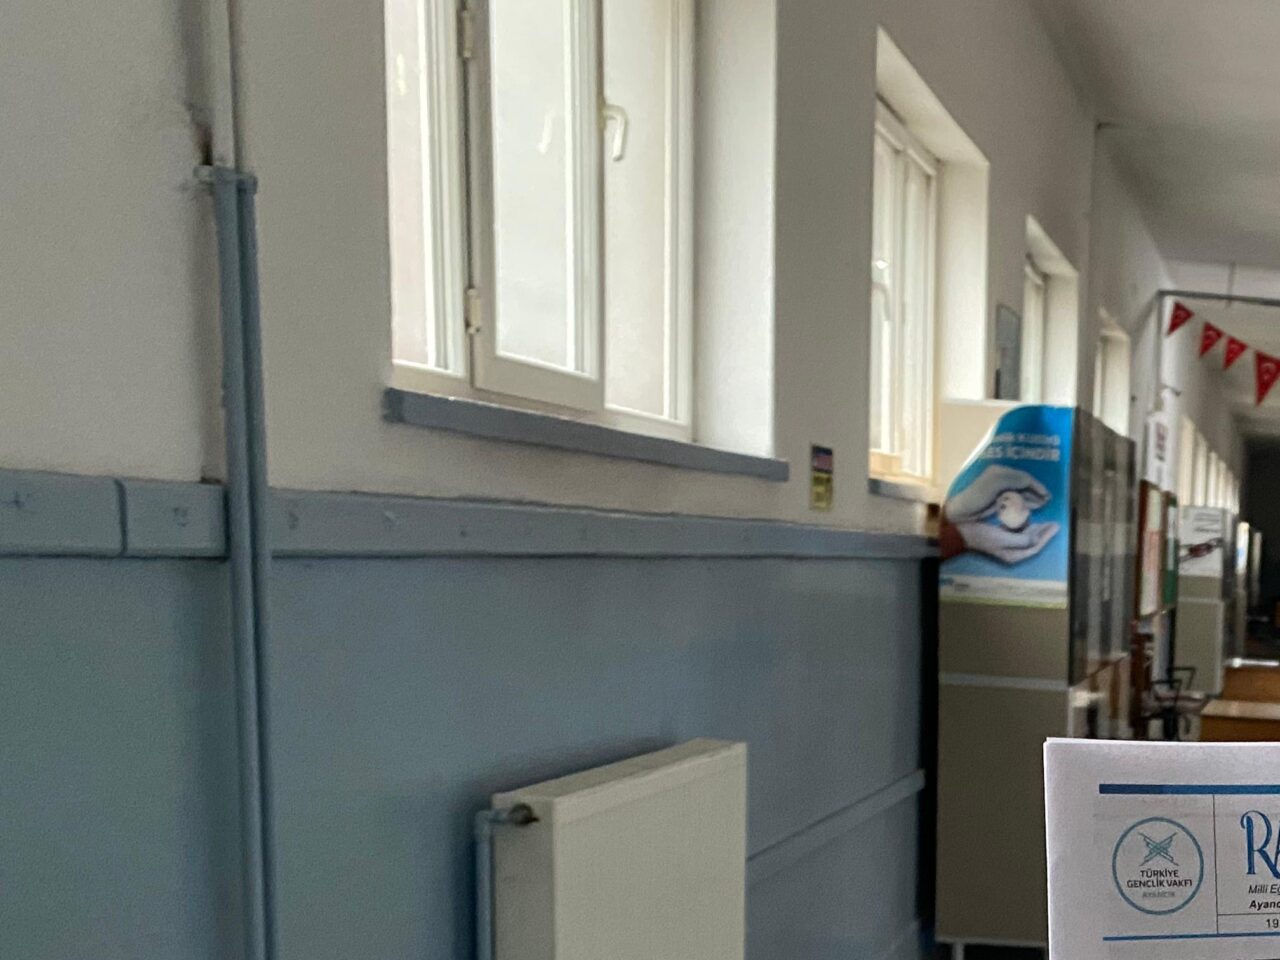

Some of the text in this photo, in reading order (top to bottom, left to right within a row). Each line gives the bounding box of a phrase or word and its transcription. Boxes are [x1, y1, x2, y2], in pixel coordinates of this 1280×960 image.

[1140, 868, 1179, 878] TÜRKİYE
[1166, 879, 1193, 887] VAKFI
[1248, 884, 1269, 894] Milli
[1266, 918, 1279, 929] 19
